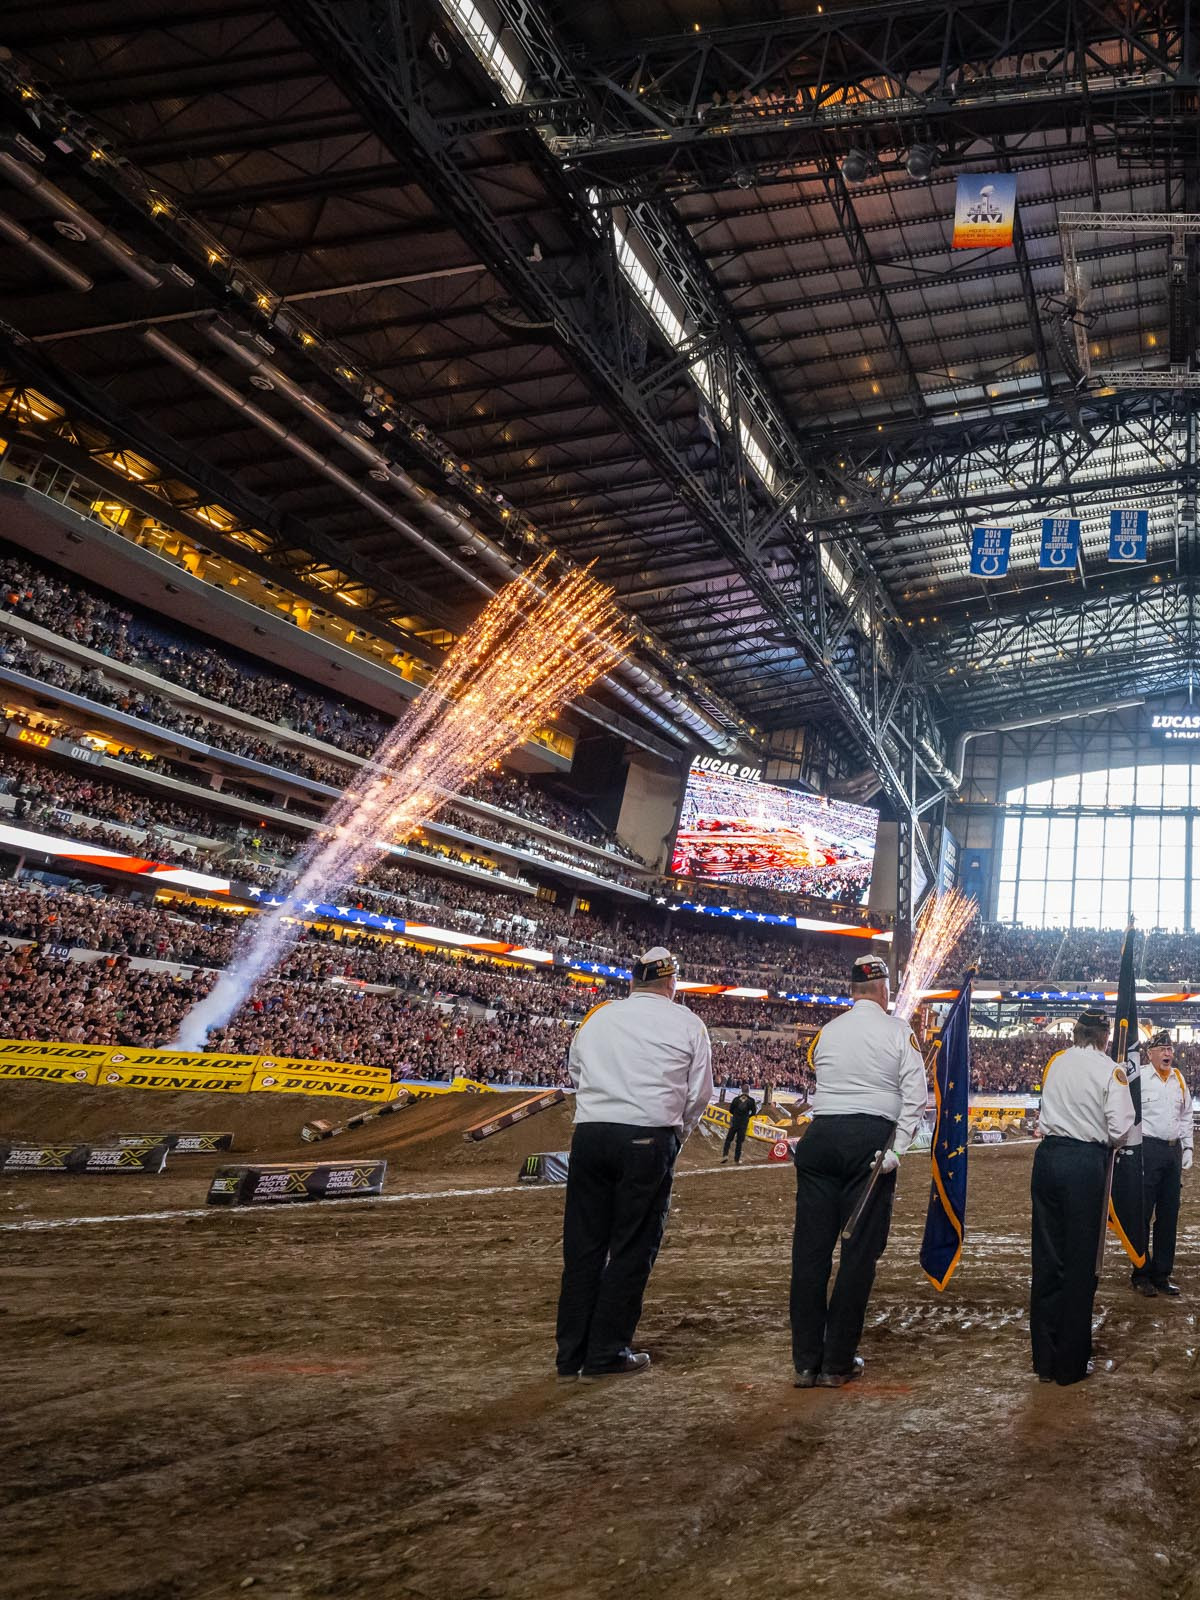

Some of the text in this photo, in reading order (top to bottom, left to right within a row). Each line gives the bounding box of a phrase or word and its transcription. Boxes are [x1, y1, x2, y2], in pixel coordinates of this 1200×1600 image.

[1152, 715, 1200, 728] LUCAS
[19, 729, 51, 748] 6:43
[71, 746, 91, 761] QTR
[691, 755, 762, 781] LUCAS OIL
[51, 947, 68, 956] 140
[2, 1045, 107, 1059] DUNLOP
[133, 1055, 252, 1069] DUNLOP
[284, 1062, 388, 1078] DUNLOP
[127, 1074, 242, 1090] DUNLOP
[281, 1078, 385, 1097] DUNLOP
